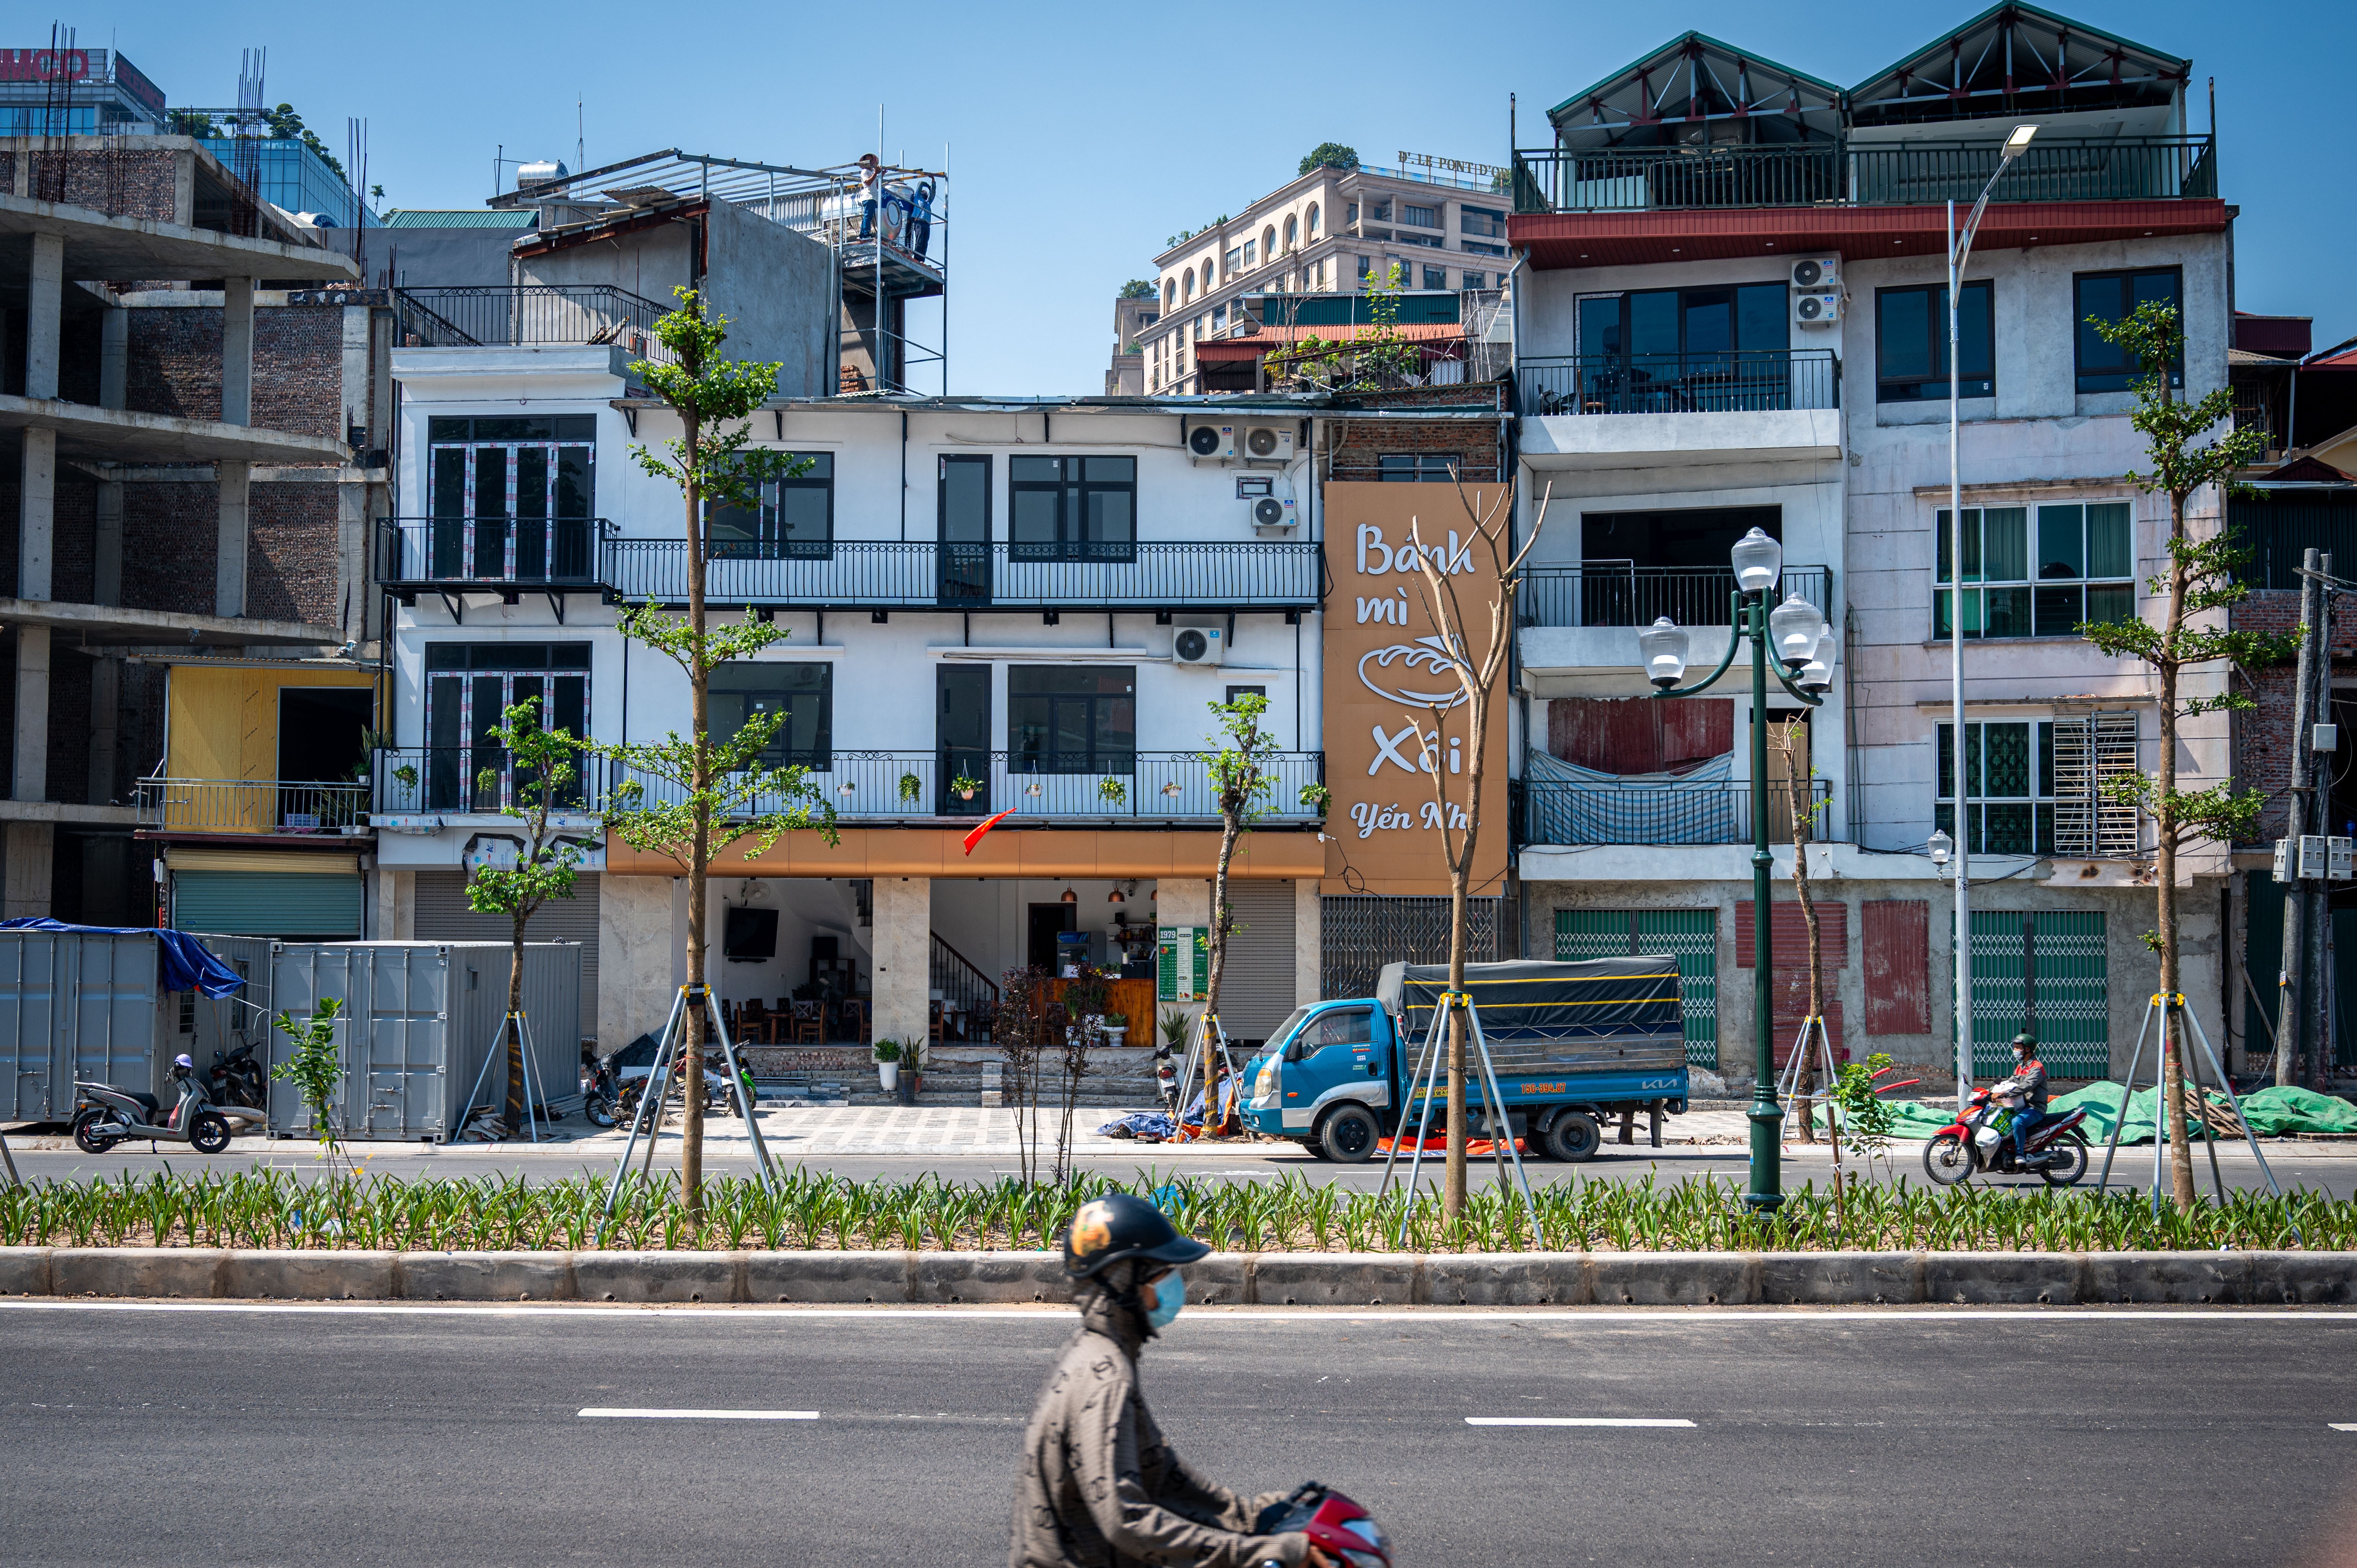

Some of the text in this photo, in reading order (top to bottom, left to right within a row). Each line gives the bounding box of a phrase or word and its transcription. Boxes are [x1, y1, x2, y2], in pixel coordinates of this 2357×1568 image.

[0, 49, 89, 80] MCO
[1439, 157, 1473, 173] PONT
[1479, 164, 1509, 179] D'OR
[1357, 523, 1475, 575] Bánh
[1356, 586, 1407, 626] mì
[1368, 725, 1461, 776] Xôi
[1350, 801, 1481, 839] Yến Nh
[1521, 1082, 1566, 1094] 15C-394.87
[1642, 1079, 1677, 1089] KIA
